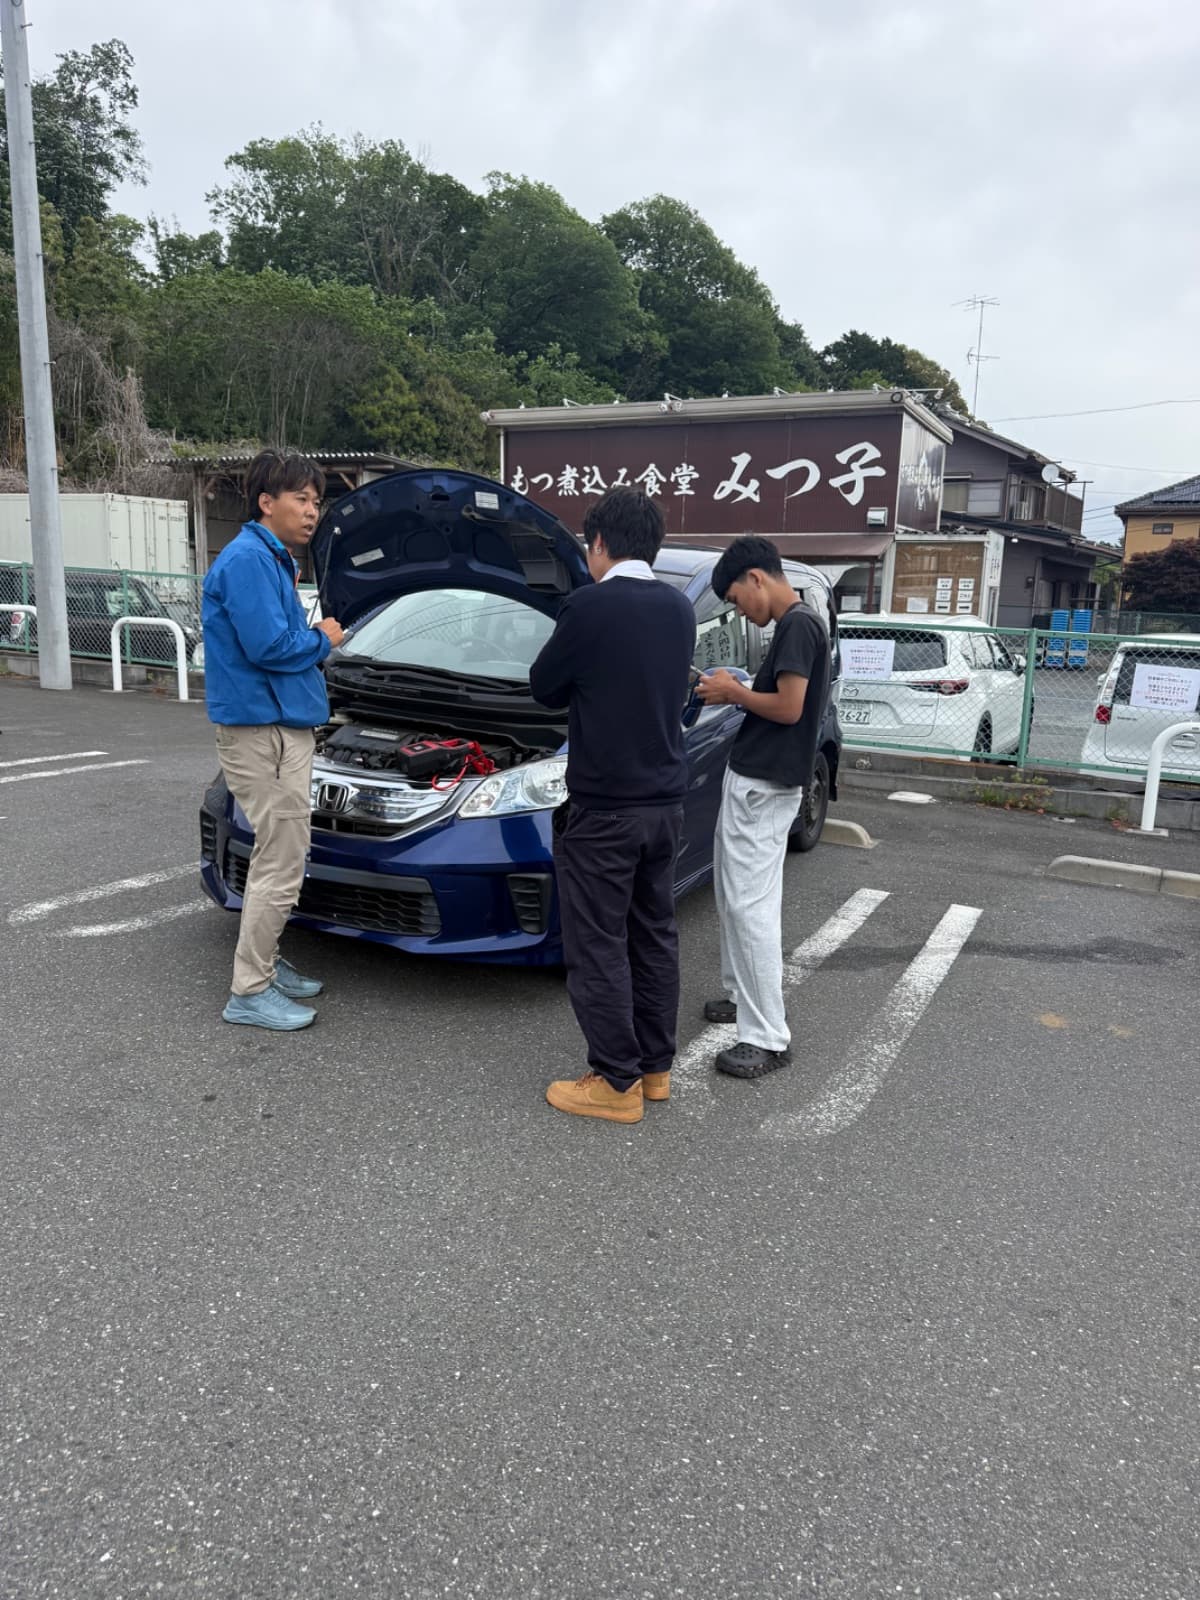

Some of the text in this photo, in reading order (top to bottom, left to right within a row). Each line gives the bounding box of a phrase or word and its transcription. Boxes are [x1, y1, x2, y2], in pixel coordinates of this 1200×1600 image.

[510, 462, 700, 498] もつ煮込み食堂
[713, 441, 887, 506] みつ子
